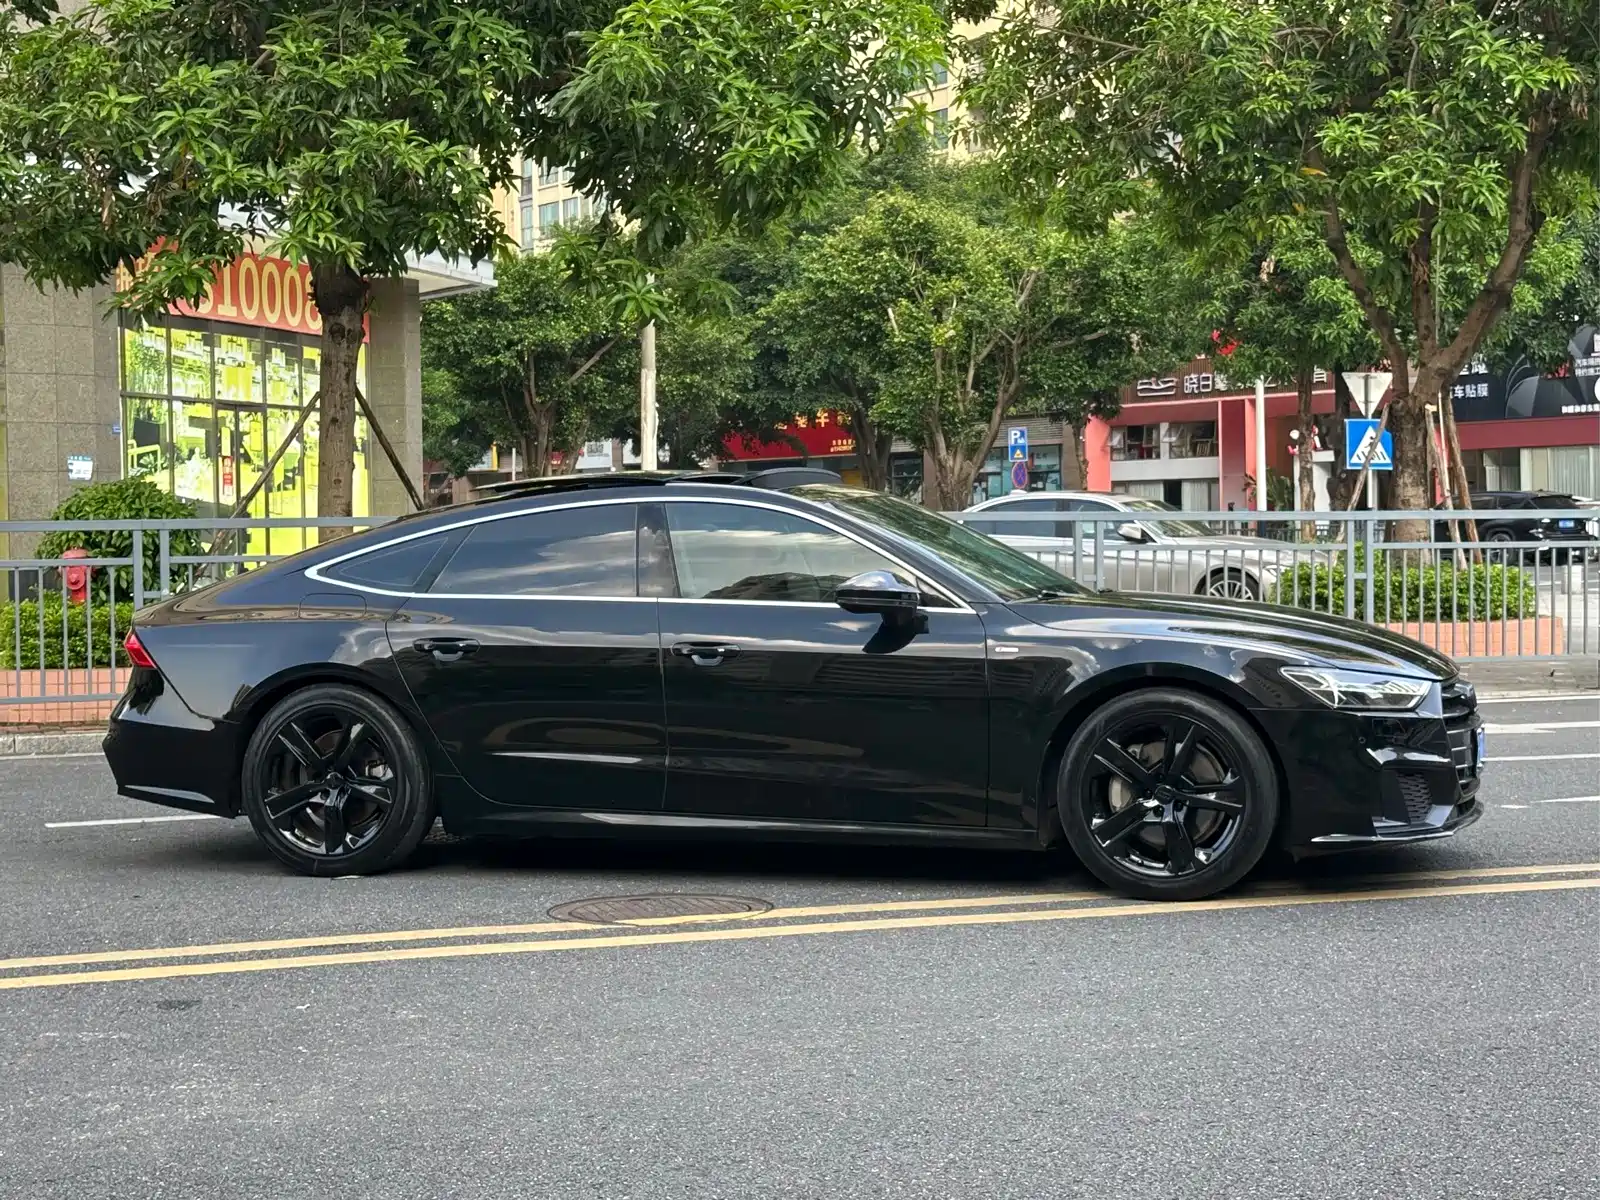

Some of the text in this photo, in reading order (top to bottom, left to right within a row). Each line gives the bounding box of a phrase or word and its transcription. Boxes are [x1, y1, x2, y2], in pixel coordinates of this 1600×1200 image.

[1450, 383, 1489, 399] 车贴膜
[1011, 430, 1021, 445] P
